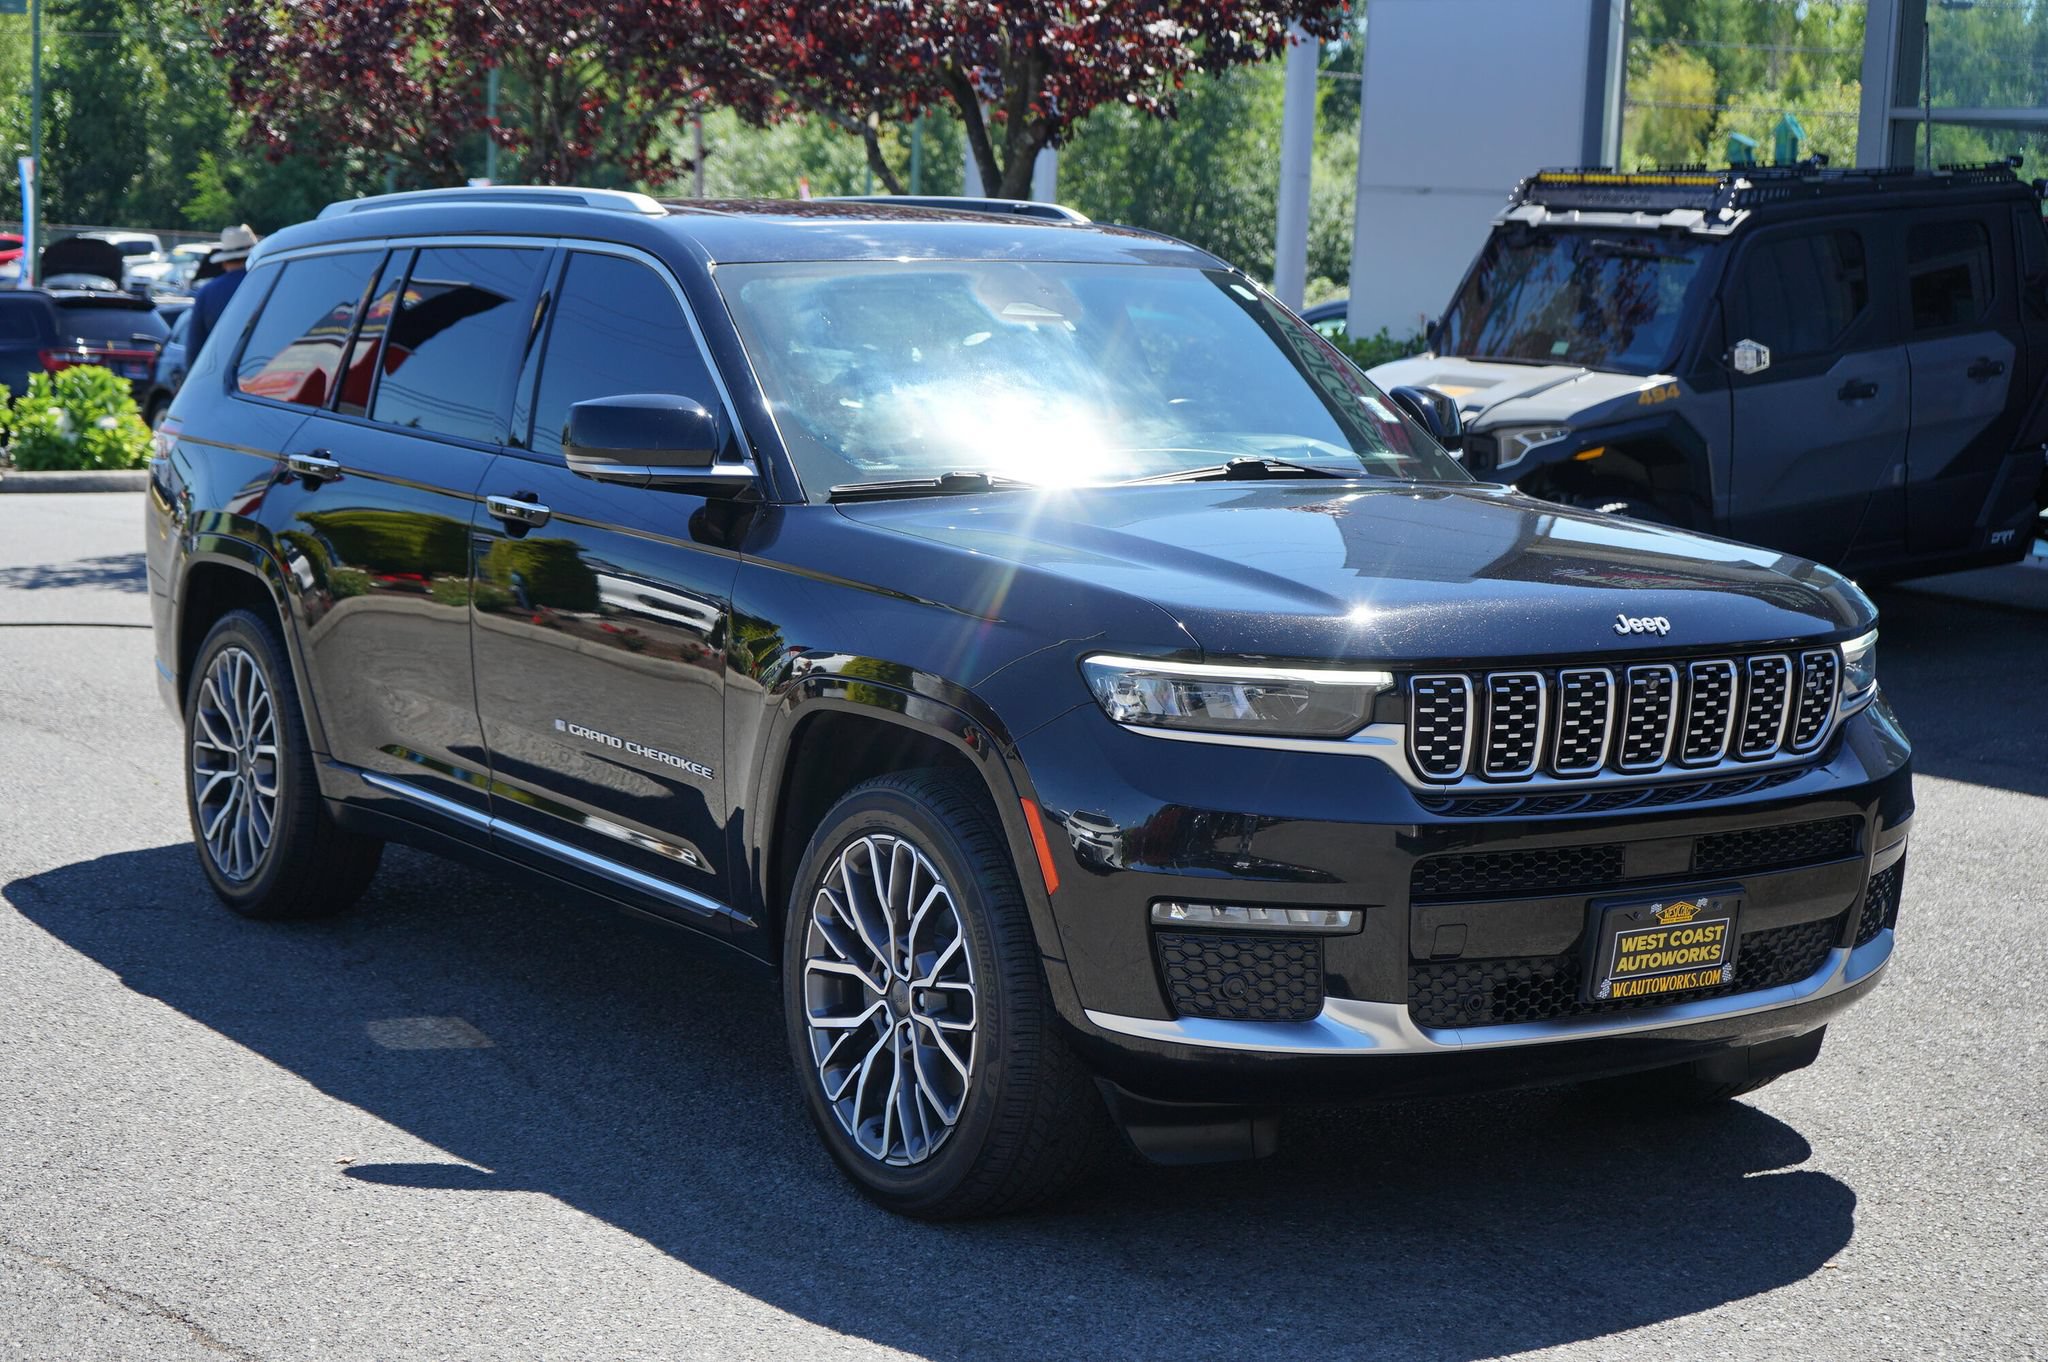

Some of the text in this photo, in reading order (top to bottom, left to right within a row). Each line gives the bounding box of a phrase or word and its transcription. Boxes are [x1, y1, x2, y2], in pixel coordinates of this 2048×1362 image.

[1638, 383, 1681, 405] 494
[1612, 614, 1671, 636] Jeep
[569, 723, 714, 780] GRAND CHEROKEE
[1621, 925, 1725, 953] WEST COAST
[1615, 944, 1721, 973] AUTOWORKS
[970, 910, 997, 1048] BRIDGESTONE
[1612, 969, 1722, 998] WCAUTOWORKS.COM
